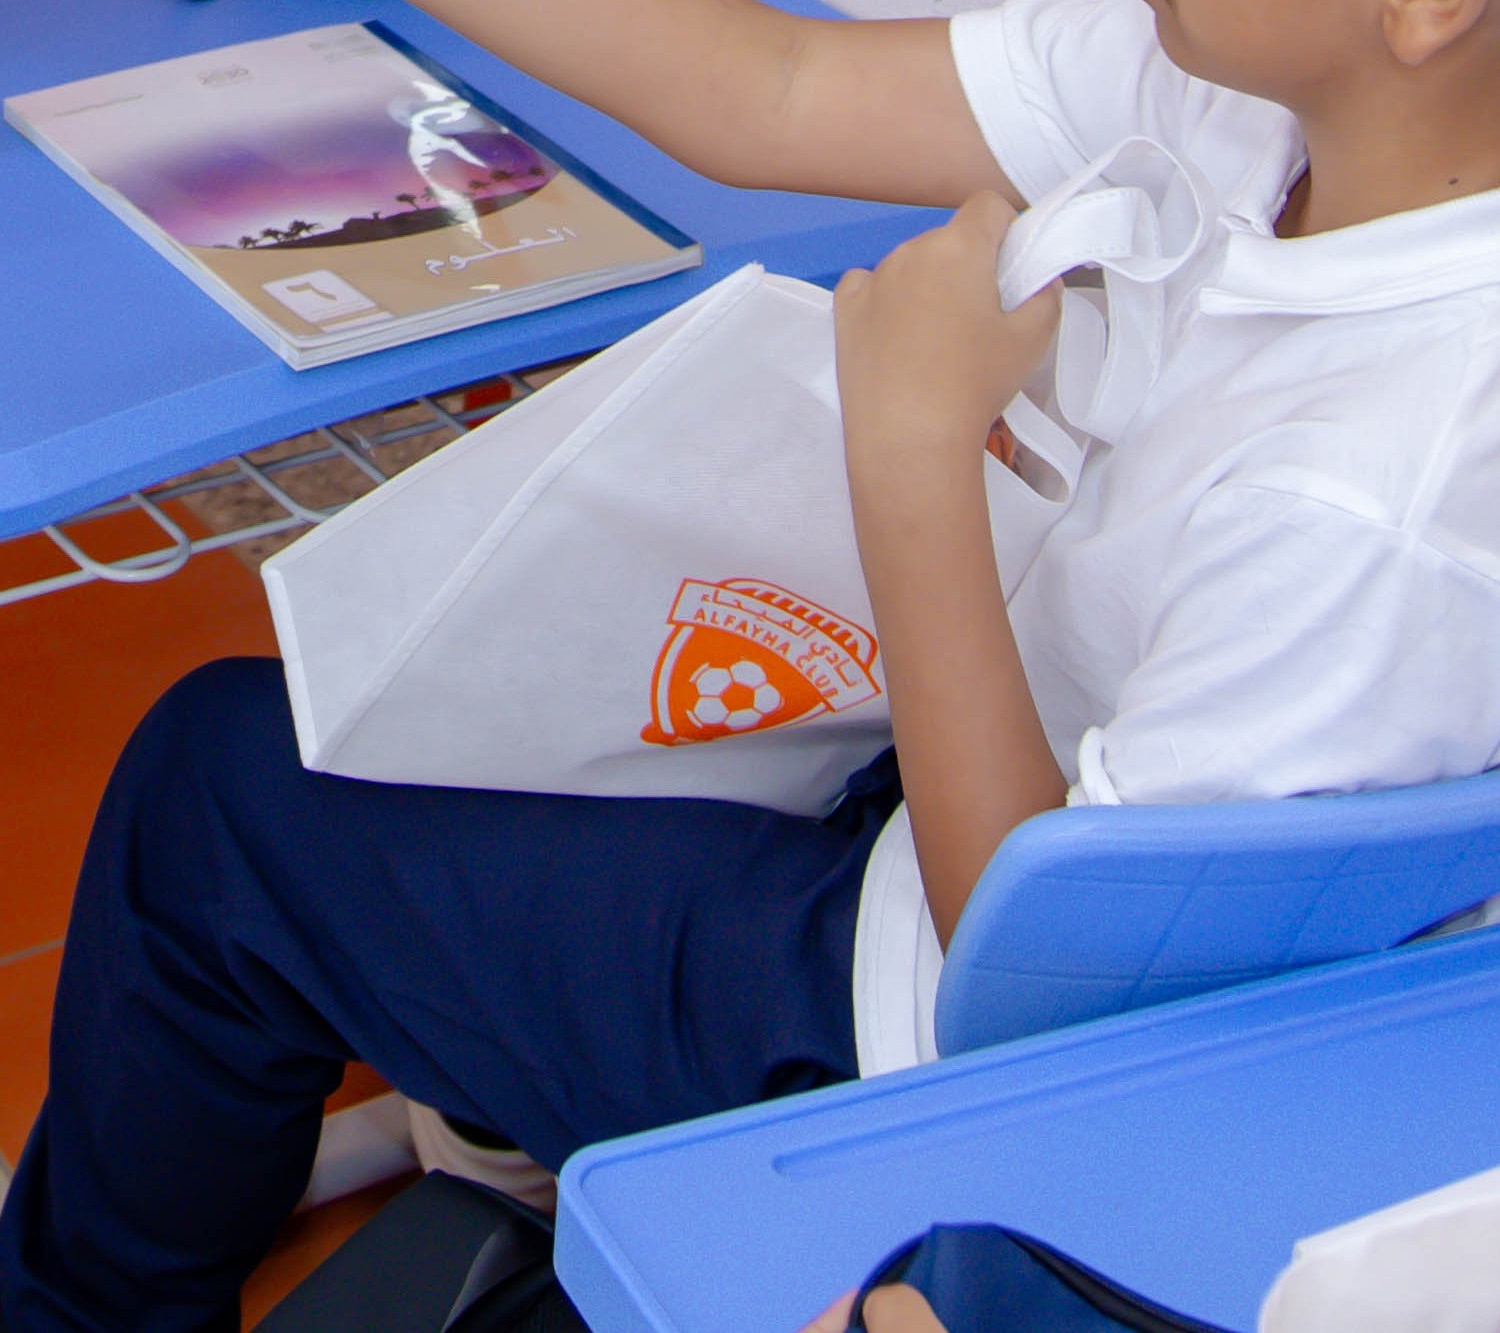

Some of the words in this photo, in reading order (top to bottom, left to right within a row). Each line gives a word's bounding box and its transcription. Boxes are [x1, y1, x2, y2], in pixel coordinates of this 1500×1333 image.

[693, 607, 791, 656] ALFAYHA
[701, 589, 817, 640] الفيحاء
[809, 641, 863, 688] نادي
